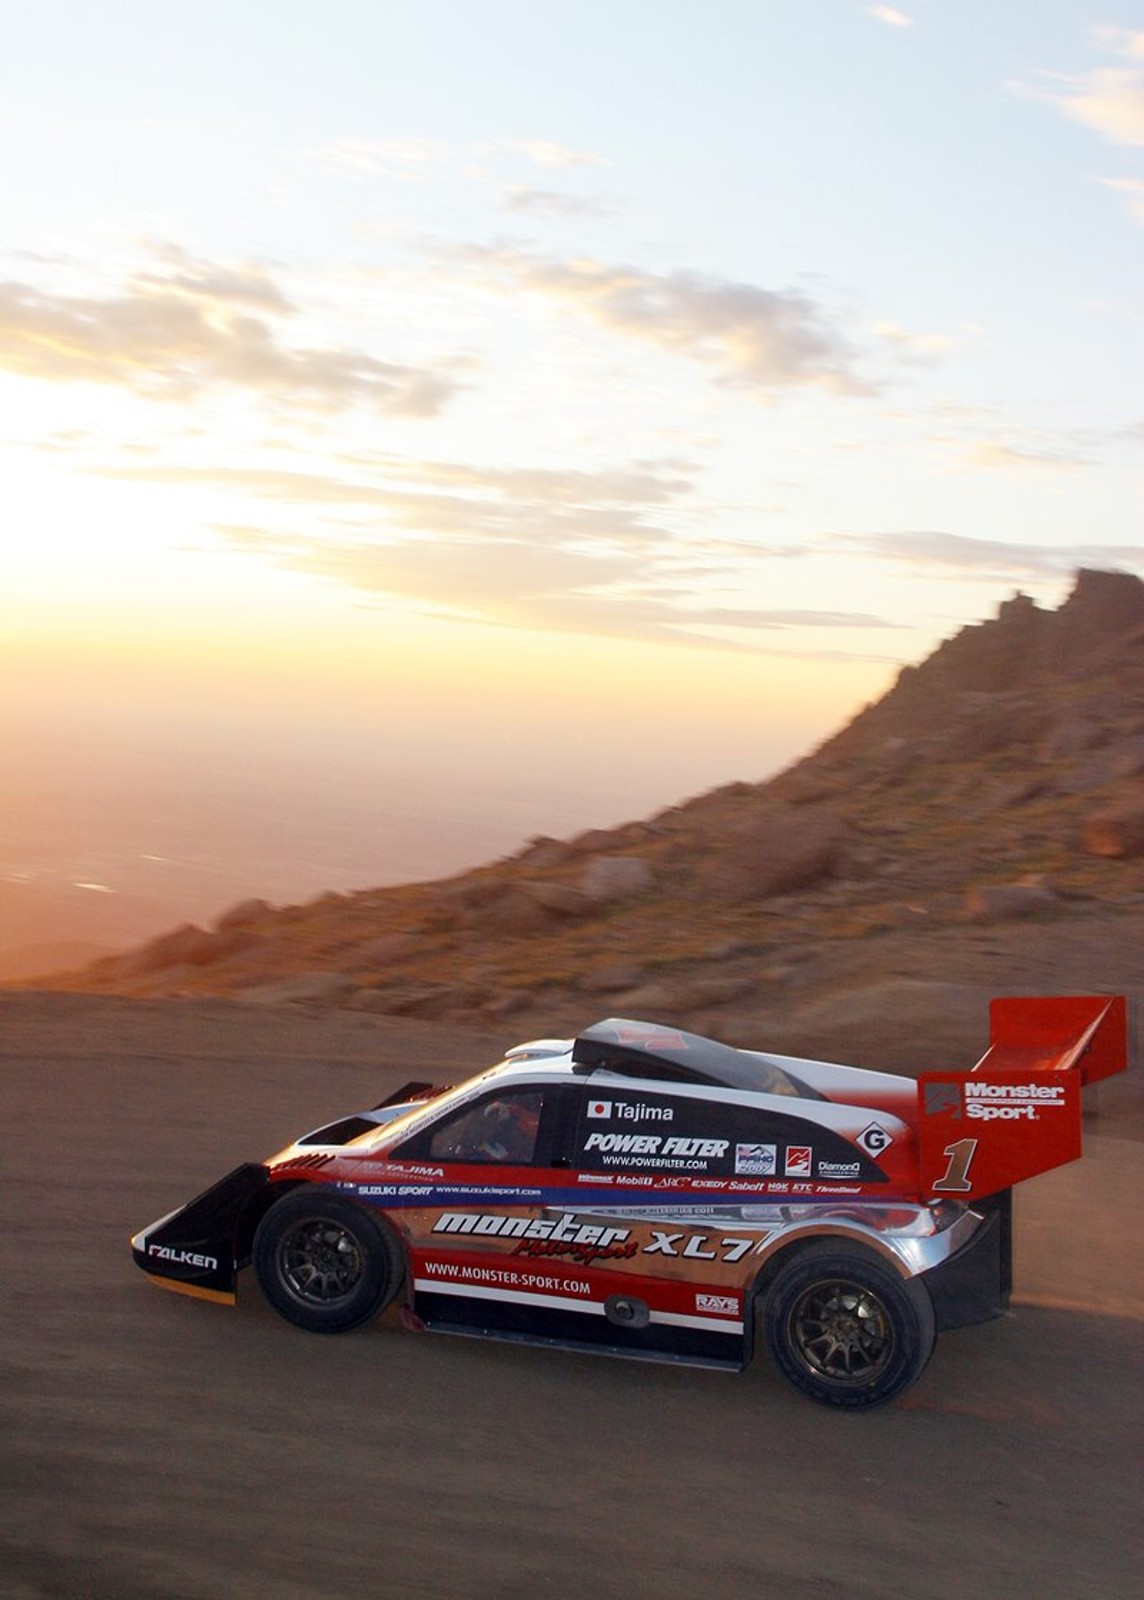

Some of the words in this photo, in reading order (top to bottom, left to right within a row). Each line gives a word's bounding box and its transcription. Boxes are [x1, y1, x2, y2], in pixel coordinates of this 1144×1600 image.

[965, 1082, 1065, 1098] Monster
[615, 1102, 674, 1122] Tajima
[966, 1103, 1036, 1121] Sport
[584, 1132, 663, 1154] POWER
[661, 1136, 730, 1158] FILTER
[863, 1129, 885, 1150] G
[386, 1164, 444, 1176] TAJIMA
[602, 1155, 708, 1170] WWW.POWERFILTER.COM
[932, 1138, 978, 1192] 1
[358, 1185, 396, 1195] SUZUKI
[397, 1186, 434, 1195] SPORT
[433, 1213, 631, 1247] monster
[148, 1244, 218, 1270] FALKEN
[424, 1262, 591, 1294] WWW.MONSTER-SPORT.COM
